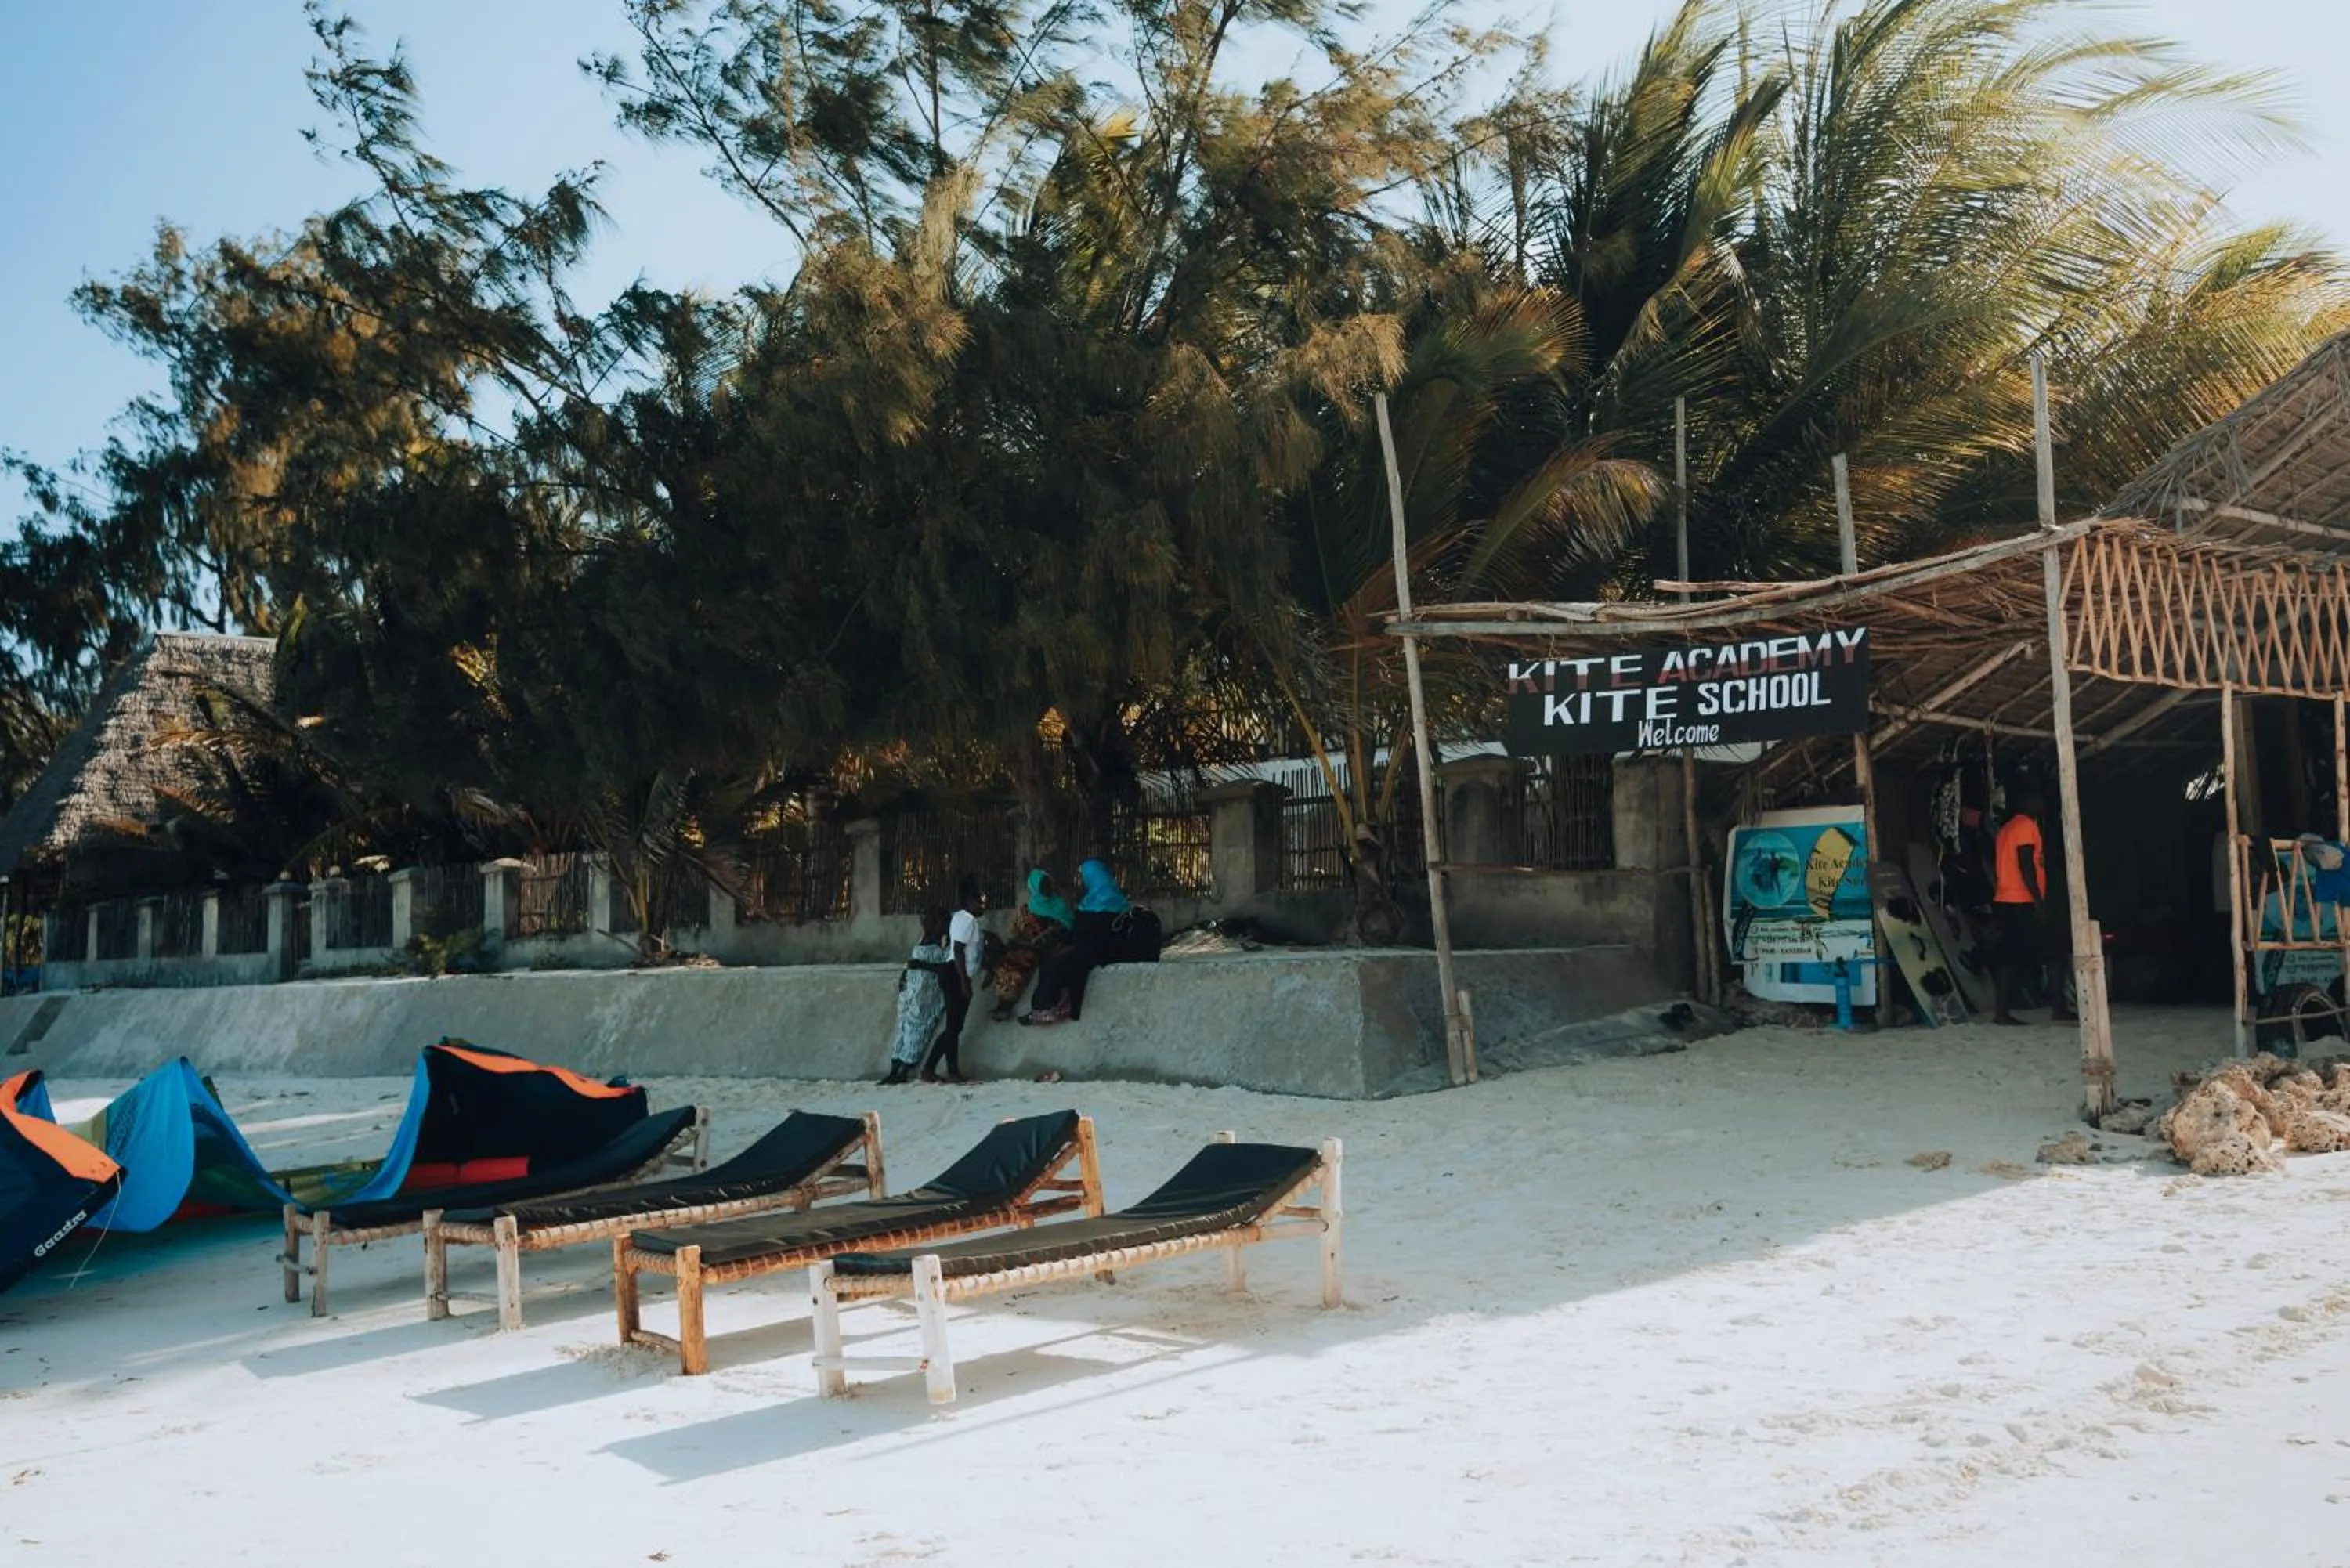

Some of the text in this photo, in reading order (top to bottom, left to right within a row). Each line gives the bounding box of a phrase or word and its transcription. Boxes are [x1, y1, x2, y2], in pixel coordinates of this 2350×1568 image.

[1507, 627, 1866, 694] KITE ACADEMY
[1544, 671, 1831, 725] KITE SCHOOL
[1638, 717, 1719, 747] Welcome
[34, 1209, 87, 1257] Gaastra
